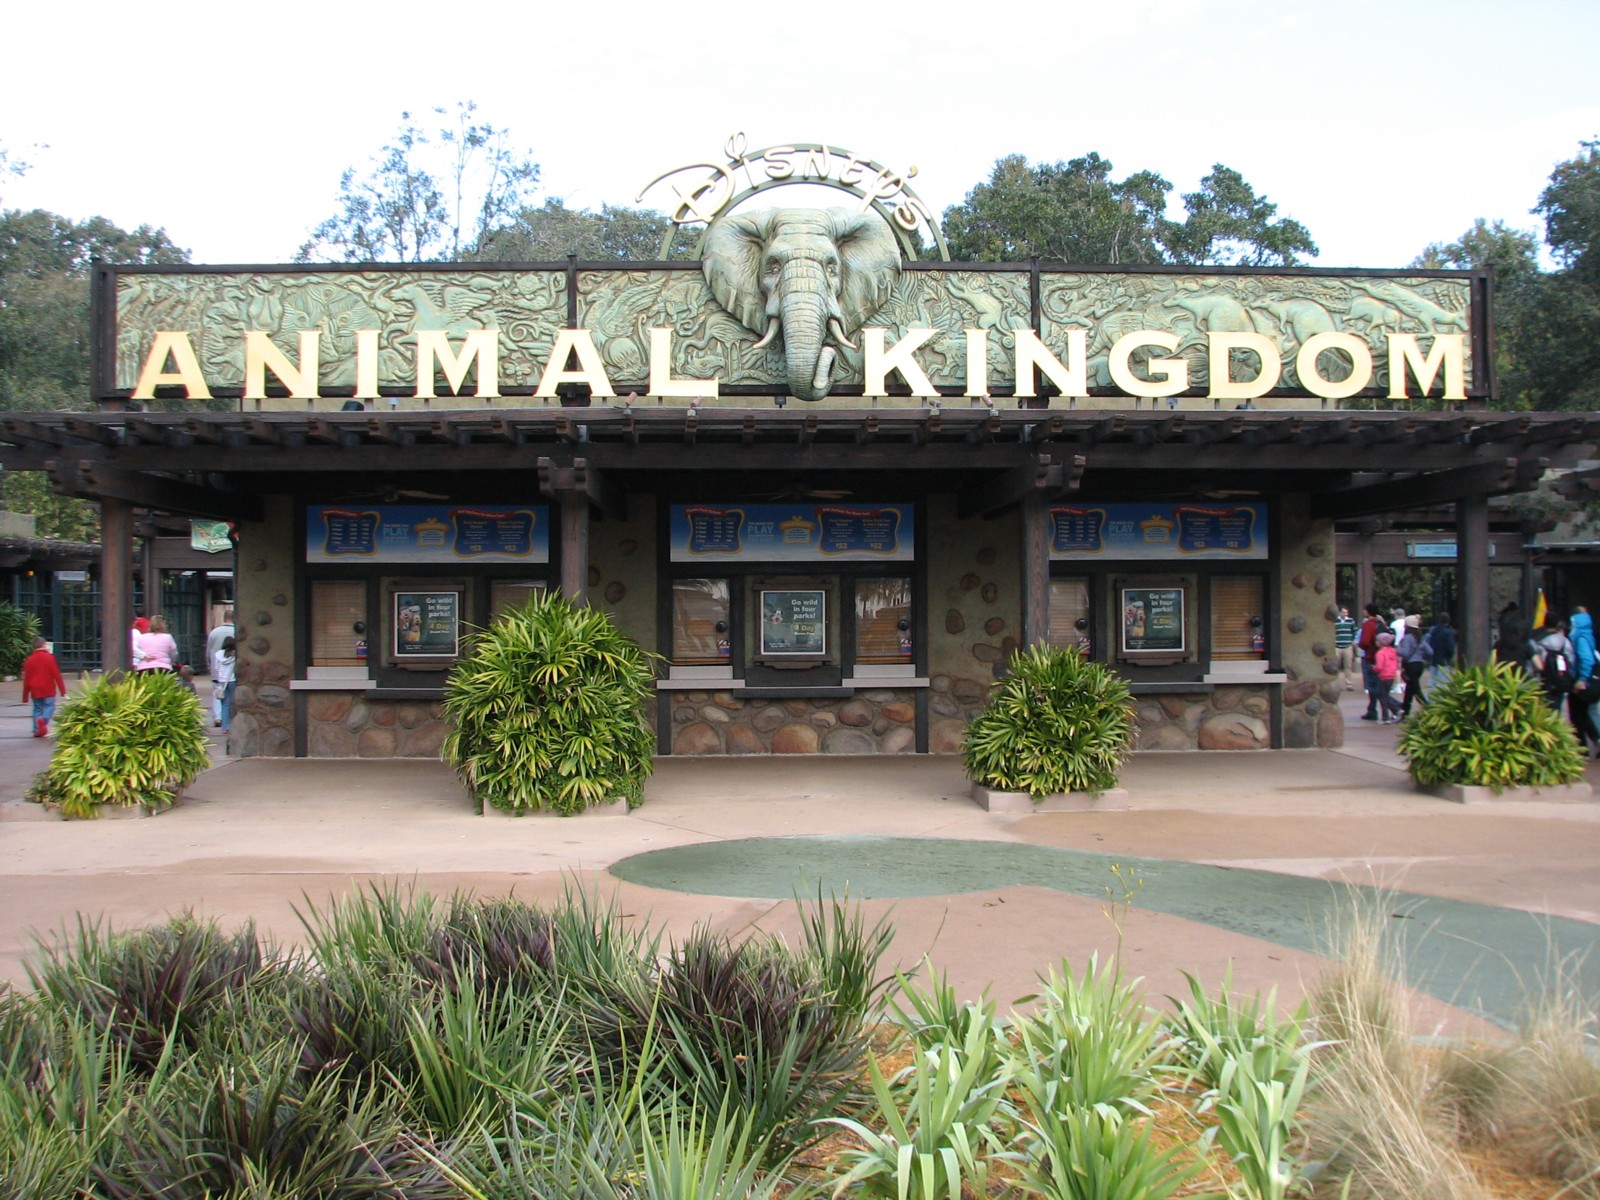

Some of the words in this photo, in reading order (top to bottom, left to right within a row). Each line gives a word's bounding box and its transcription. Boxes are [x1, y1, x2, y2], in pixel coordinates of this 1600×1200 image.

[130, 328, 719, 400] ANIMAL
[861, 327, 1469, 401] KINGDOM
[383, 527, 409, 537] PLAY
[747, 525, 774, 535] PLAY
[1108, 524, 1134, 534] PLAY
[1152, 606, 1173, 614] parks!
